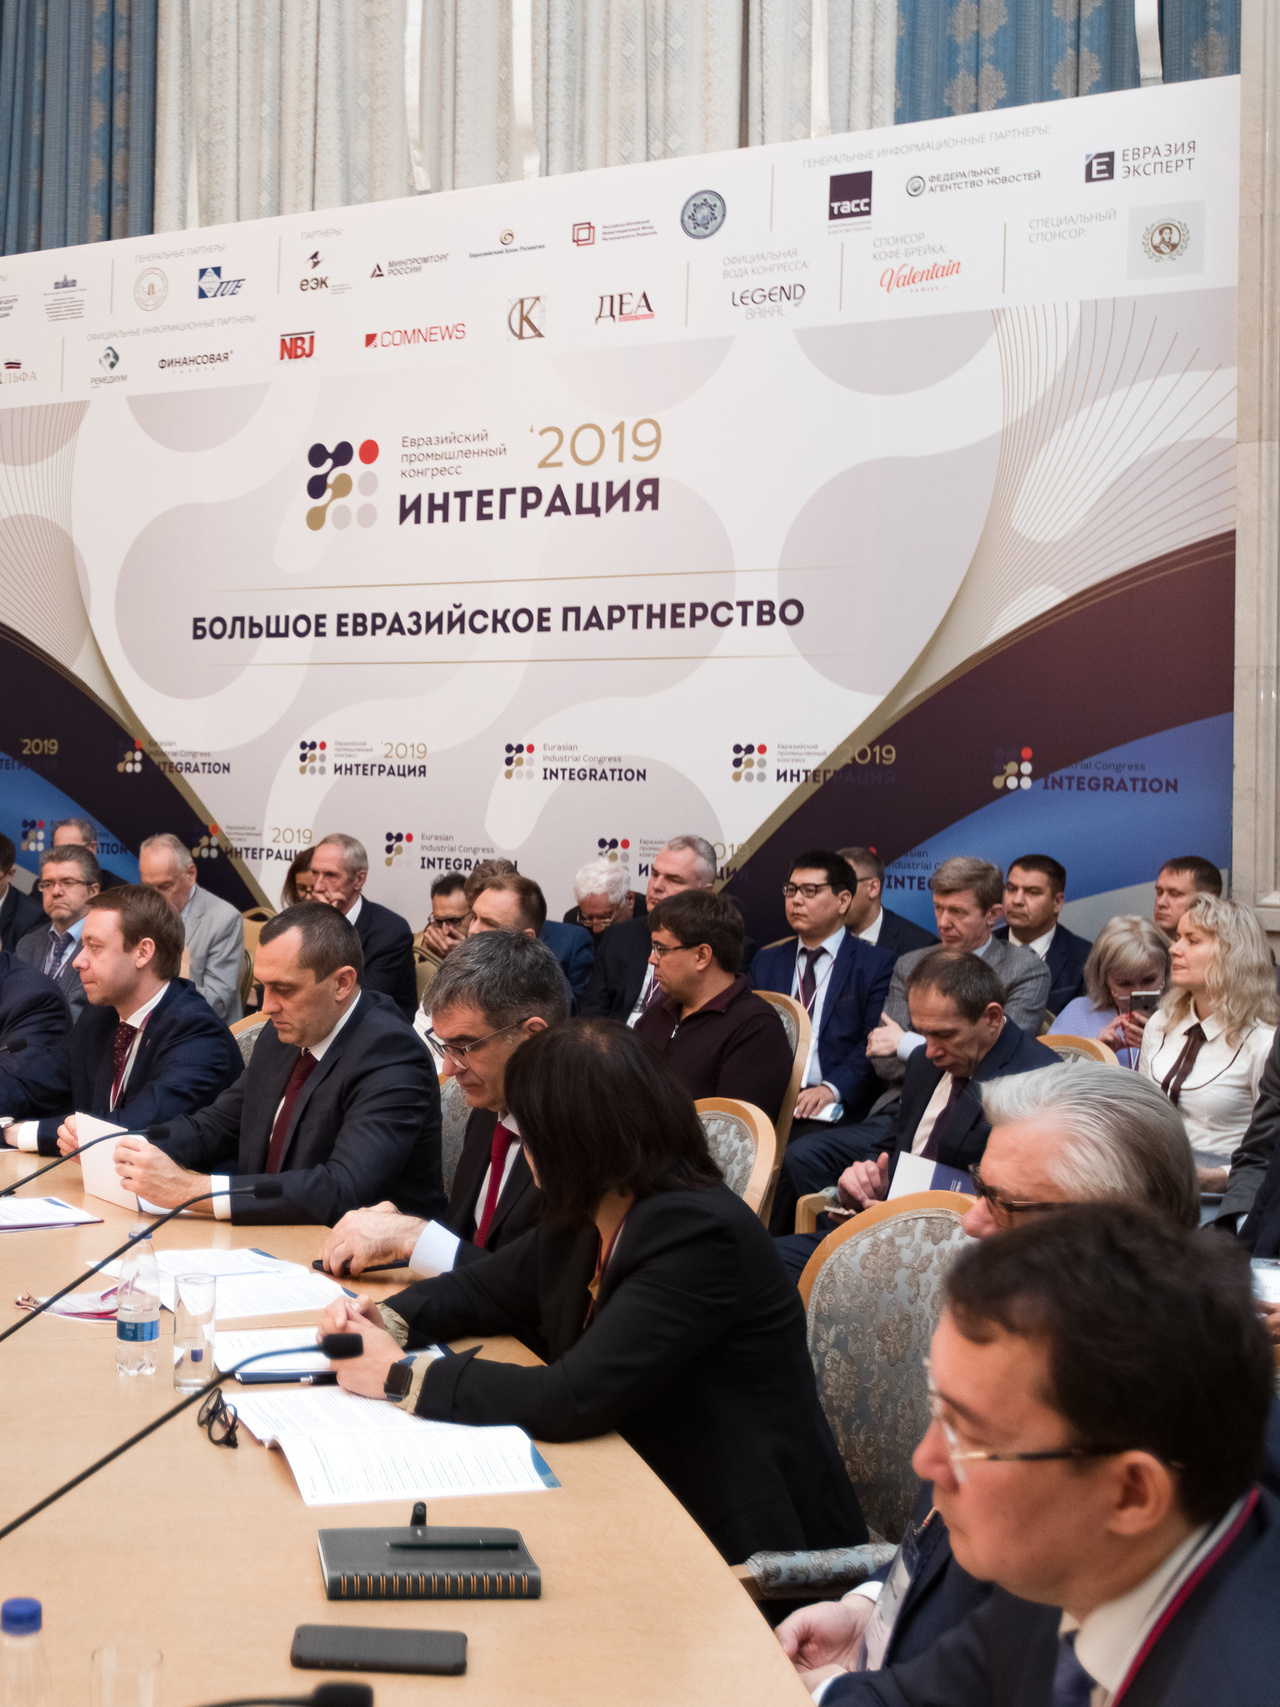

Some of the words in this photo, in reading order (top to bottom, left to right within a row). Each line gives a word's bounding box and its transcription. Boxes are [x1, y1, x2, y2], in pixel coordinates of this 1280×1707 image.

[802, 149, 874, 169] ГЕНЕРАЛЬНЫЕ
[877, 132, 987, 158] ИНФОРМАЦИОННЫЕ
[1122, 140, 1197, 162] ЕВРАЗИЯ
[928, 166, 1001, 183] ФЕДЕРАЛЬНОЕ
[1122, 157, 1195, 179] ЭКСПЕРТ
[928, 179, 984, 194] АГЕНТСТВО
[986, 170, 1042, 187] НОВОСТЕЙ
[1028, 208, 1117, 230] СПЕЦИАЛЬНЫЙ
[872, 232, 925, 248] СПОНСОР
[1028, 228, 1089, 244] СПОНСОР:
[387, 253, 450, 268] МИНПРОМТОРГ
[722, 247, 799, 267] ОФИЦИАЛЬНАЯ
[387, 266, 422, 277] РОССИИ
[722, 267, 749, 280] ВОДА
[880, 259, 961, 293] Valentain
[731, 283, 806, 307] LEGEND
[595, 291, 654, 325] ДЕА
[745, 304, 786, 321] BAIKAL
[86, 328, 141, 342] ОФИЦИАЛЬНЫЕ
[142, 318, 216, 334] ИНФОРМАЦИОННЫЕ
[380, 322, 466, 349] COMNEWS
[279, 334, 315, 361] NBJ
[158, 352, 229, 369] ФИНАНСОВАЯ
[90, 374, 128, 385] РЕМЕДИУМ
[402, 428, 490, 449] Евразийский
[400, 444, 507, 466] промышленный
[400, 464, 463, 480] конгресс
[399, 477, 661, 526] ИНТЕГРАЦИЯ
[192, 613, 328, 641] БОЛЬШОЕ
[336, 603, 552, 639] ЕВРАЗИЙСКОЕ
[561, 597, 805, 632] ПАРТНЕРСТВО
[543, 743, 578, 751] Eurasian
[543, 754, 581, 763] Industrial
[583, 754, 622, 765] Congress
[1094, 761, 1146, 774] Congress
[334, 763, 427, 778] ИНТЕГРАЦИЯ
[542, 767, 647, 782] INTEGRATION
[1042, 775, 1178, 794] INTEGRATION
[421, 833, 454, 841] Eurasian
[224, 847, 302, 862] ИНТЕГРАЦ
[421, 844, 456, 852] Industrial
[458, 845, 495, 856] Congress
